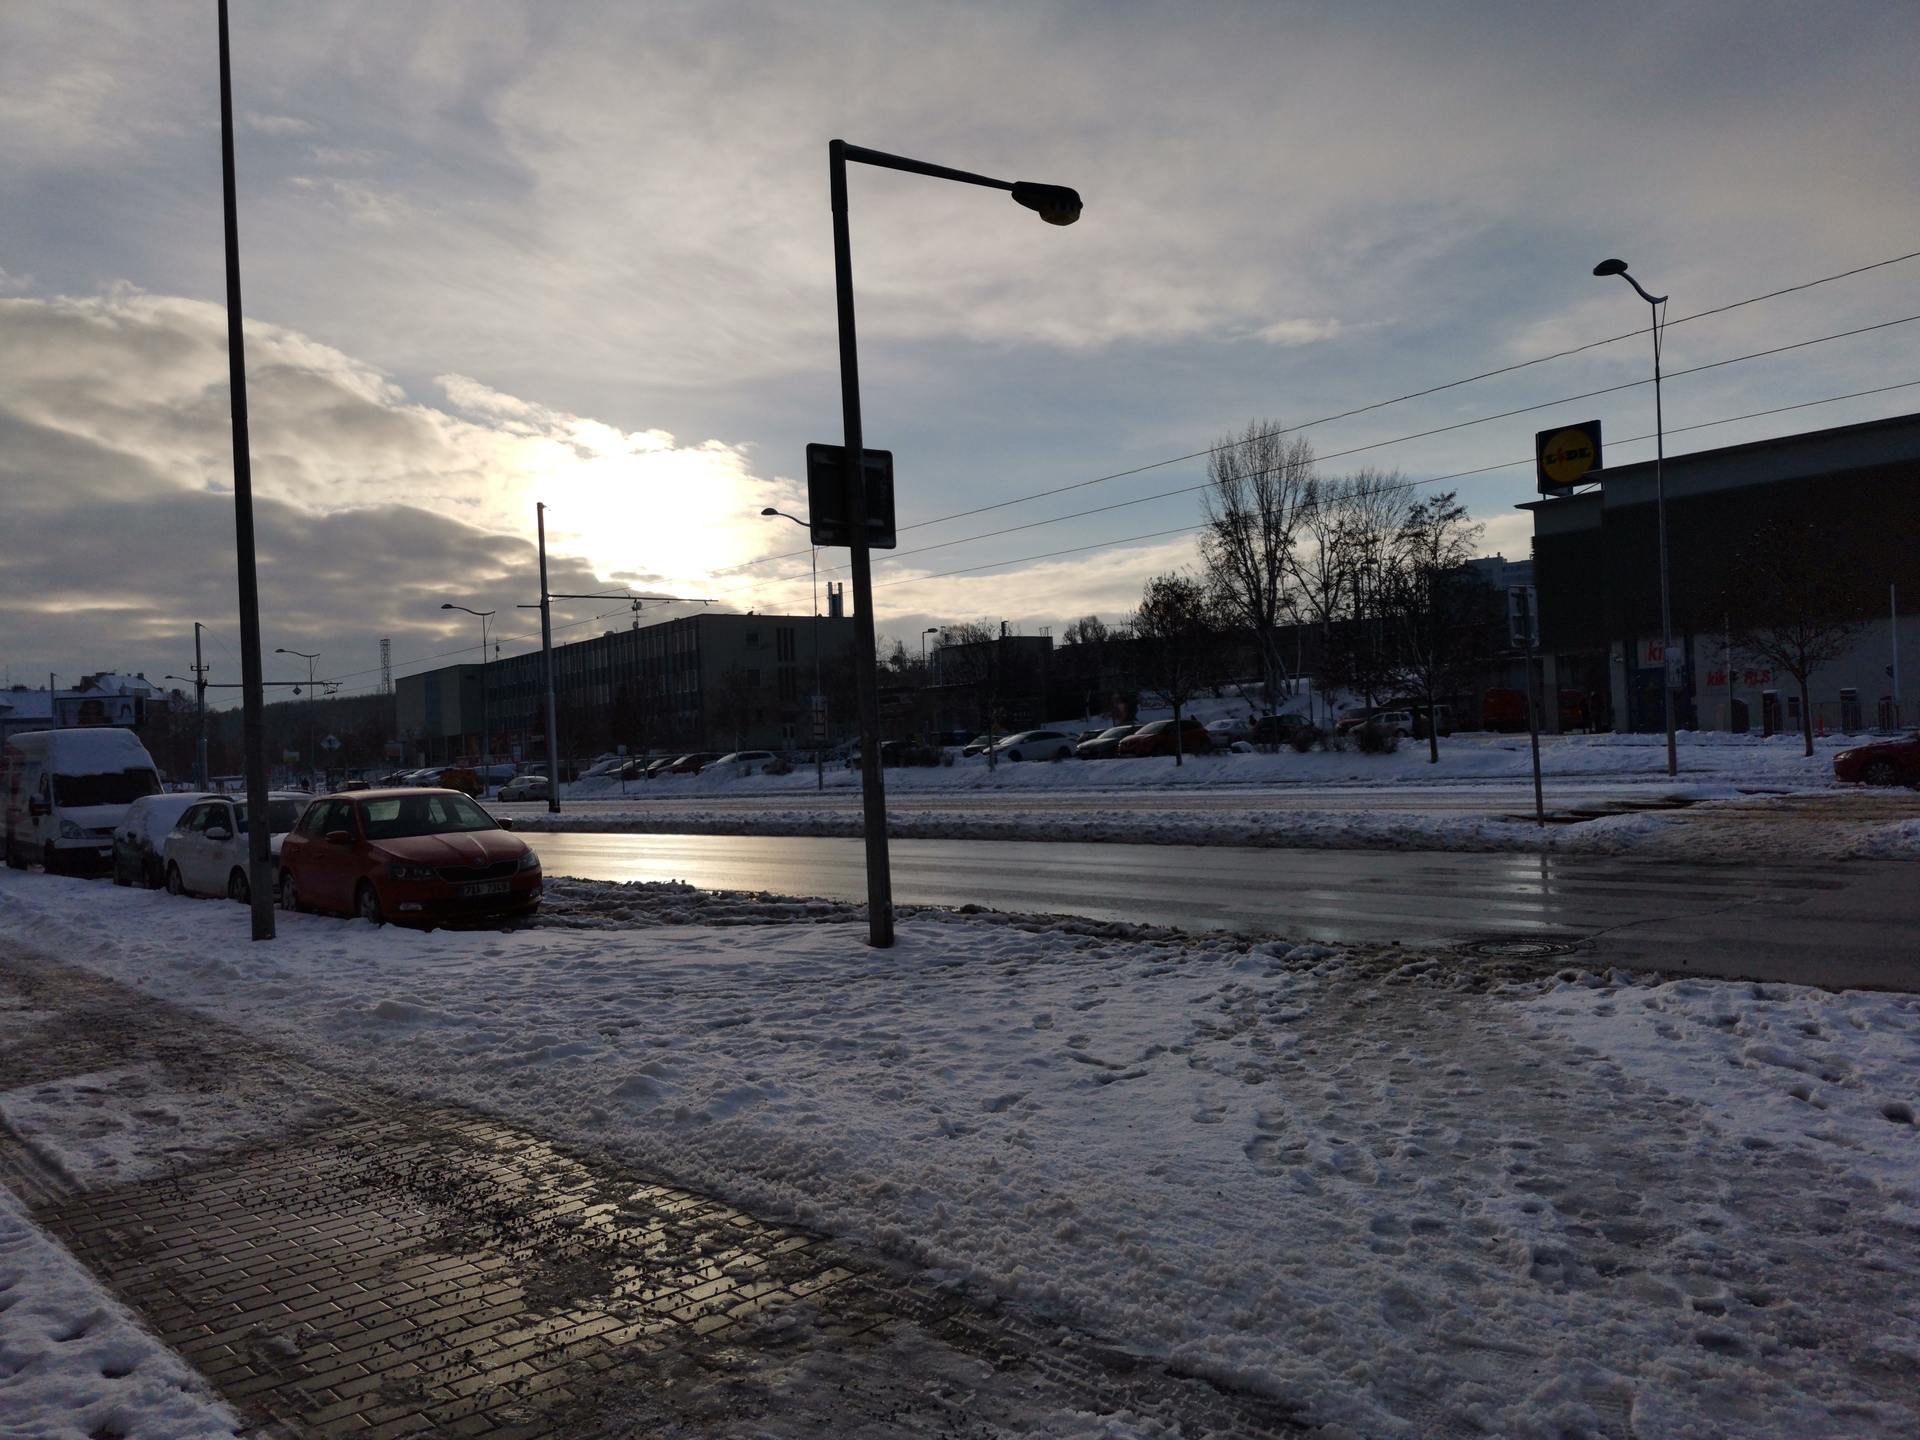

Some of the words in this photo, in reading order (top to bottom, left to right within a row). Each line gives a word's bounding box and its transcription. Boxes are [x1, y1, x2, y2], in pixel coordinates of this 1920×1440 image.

[1648, 640, 1666, 661] ki
[1707, 669, 1726, 687] kik
[476, 757, 513, 766] JELNA
[487, 882, 507, 893] 7349
